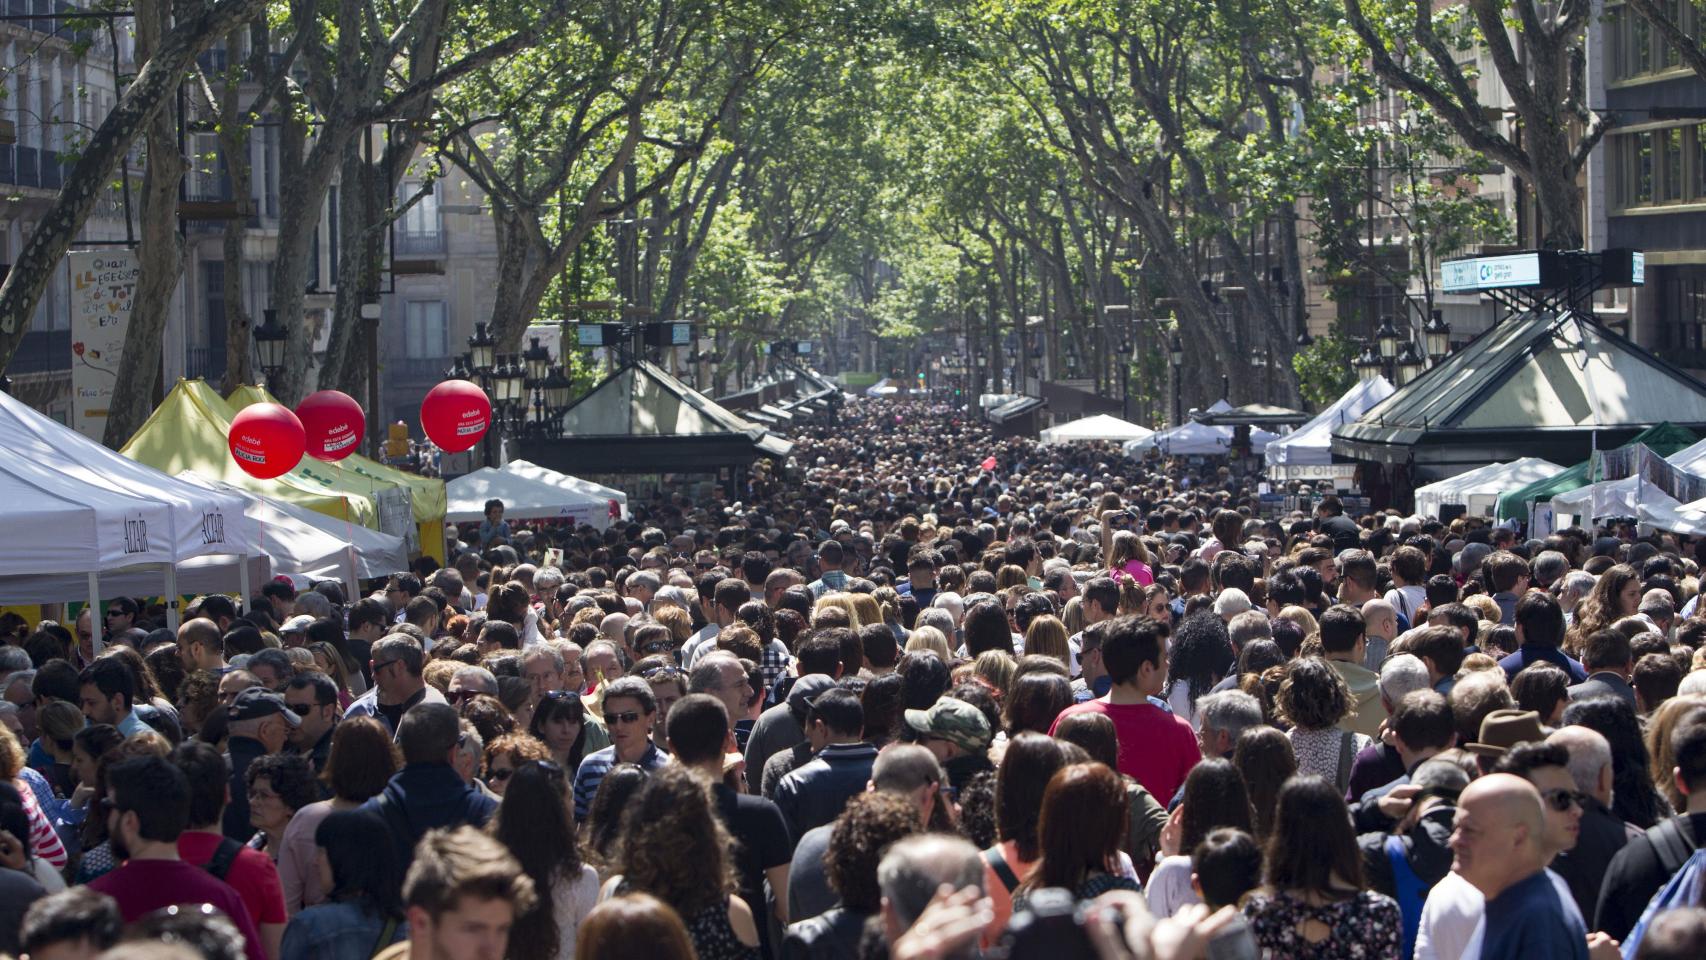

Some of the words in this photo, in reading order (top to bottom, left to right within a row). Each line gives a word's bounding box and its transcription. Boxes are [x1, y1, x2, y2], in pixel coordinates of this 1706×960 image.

[462, 408, 480, 419] edebé
[328, 423, 348, 435] edebé
[242, 435, 261, 446] edebé
